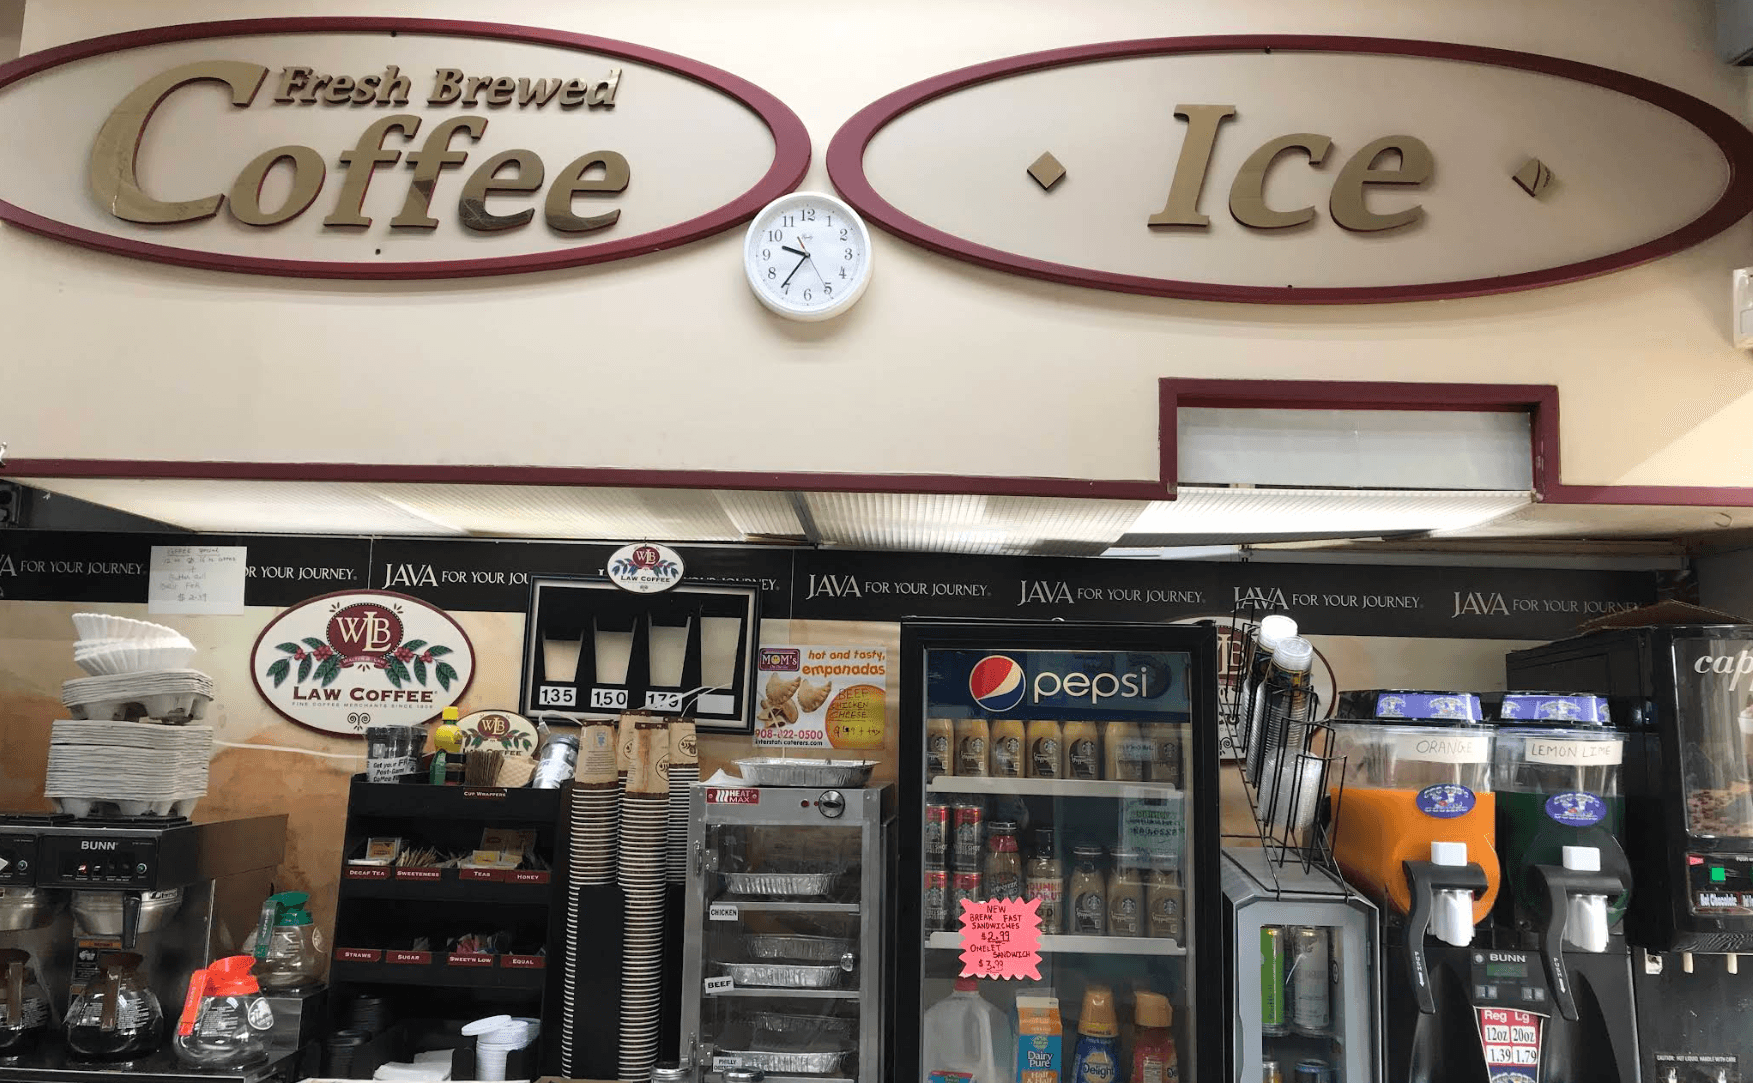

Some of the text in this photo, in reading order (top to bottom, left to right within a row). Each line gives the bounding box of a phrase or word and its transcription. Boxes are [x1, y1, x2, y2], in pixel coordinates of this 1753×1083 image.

[274, 65, 623, 108] Fresh Brewed
[91, 60, 631, 233] Coffee
[1147, 103, 1435, 232] Ice
[800, 209, 815, 221] 12
[827, 215, 831, 227] 1
[783, 216, 795, 228] 11
[768, 229, 782, 242] 10
[840, 229, 847, 241] 2
[762, 249, 771, 261] 9
[844, 248, 853, 260] 3
[767, 267, 776, 279] 8
[839, 266, 848, 279] 4
[784, 282, 790, 295] 7
[803, 288, 812, 301] 6
[823, 282, 832, 294] 5
[20, 560, 46, 573] FOR
[50, 560, 83, 573] YOUR
[244, 566, 257, 578] OR
[261, 566, 294, 579] YOUR
[382, 563, 438, 590] JAVA
[442, 570, 467, 583] FOR
[472, 571, 504, 584] YOUR
[641, 575, 671, 583] COFFEE
[805, 573, 863, 600] JAVA
[865, 581, 891, 594] FOR
[894, 582, 929, 595] YOUR
[1017, 580, 1075, 607] JAVA
[1077, 588, 1103, 600] FOR
[1107, 588, 1142, 602] YOUR
[1230, 586, 1289, 613] JAVA
[1292, 594, 1319, 606] FOR
[1323, 594, 1359, 608] YOUR
[1451, 591, 1511, 619] JAVA
[1513, 599, 1539, 611] FOR
[1543, 600, 1579, 613] YOUR
[808, 650, 885, 662] hot and tasty,
[802, 663, 885, 678] empanadas
[1694, 650, 1753, 692] cap
[1034, 667, 1147, 704] pepsi
[293, 686, 434, 703] LAW COFFEE
[541, 689, 573, 705] 1.35
[593, 692, 626, 706] 1.50
[1416, 740, 1473, 755] ORANGE
[1531, 743, 1612, 758] LEMON LIME
[81, 841, 116, 851] BUNN
[710, 908, 737, 917] CHICKEN
[986, 905, 1006, 914] NEW
[970, 914, 1022, 923] BREAK FAST
[971, 922, 1020, 930] SANDWICHES
[345, 951, 372, 959] STRAWS
[970, 944, 1002, 953] OMELET
[477, 956, 492, 964] LOW
[1490, 953, 1526, 962] BUNN
[708, 980, 731, 989] BEEF
[1484, 1010, 1530, 1024] Reg Lg
[1487, 1027, 1535, 1042] 12oz 20oz
[1028, 1051, 1053, 1060] Dairy
[1491, 1048, 1537, 1063] 1.39 1.79
[1030, 1060, 1050, 1068] Pure
